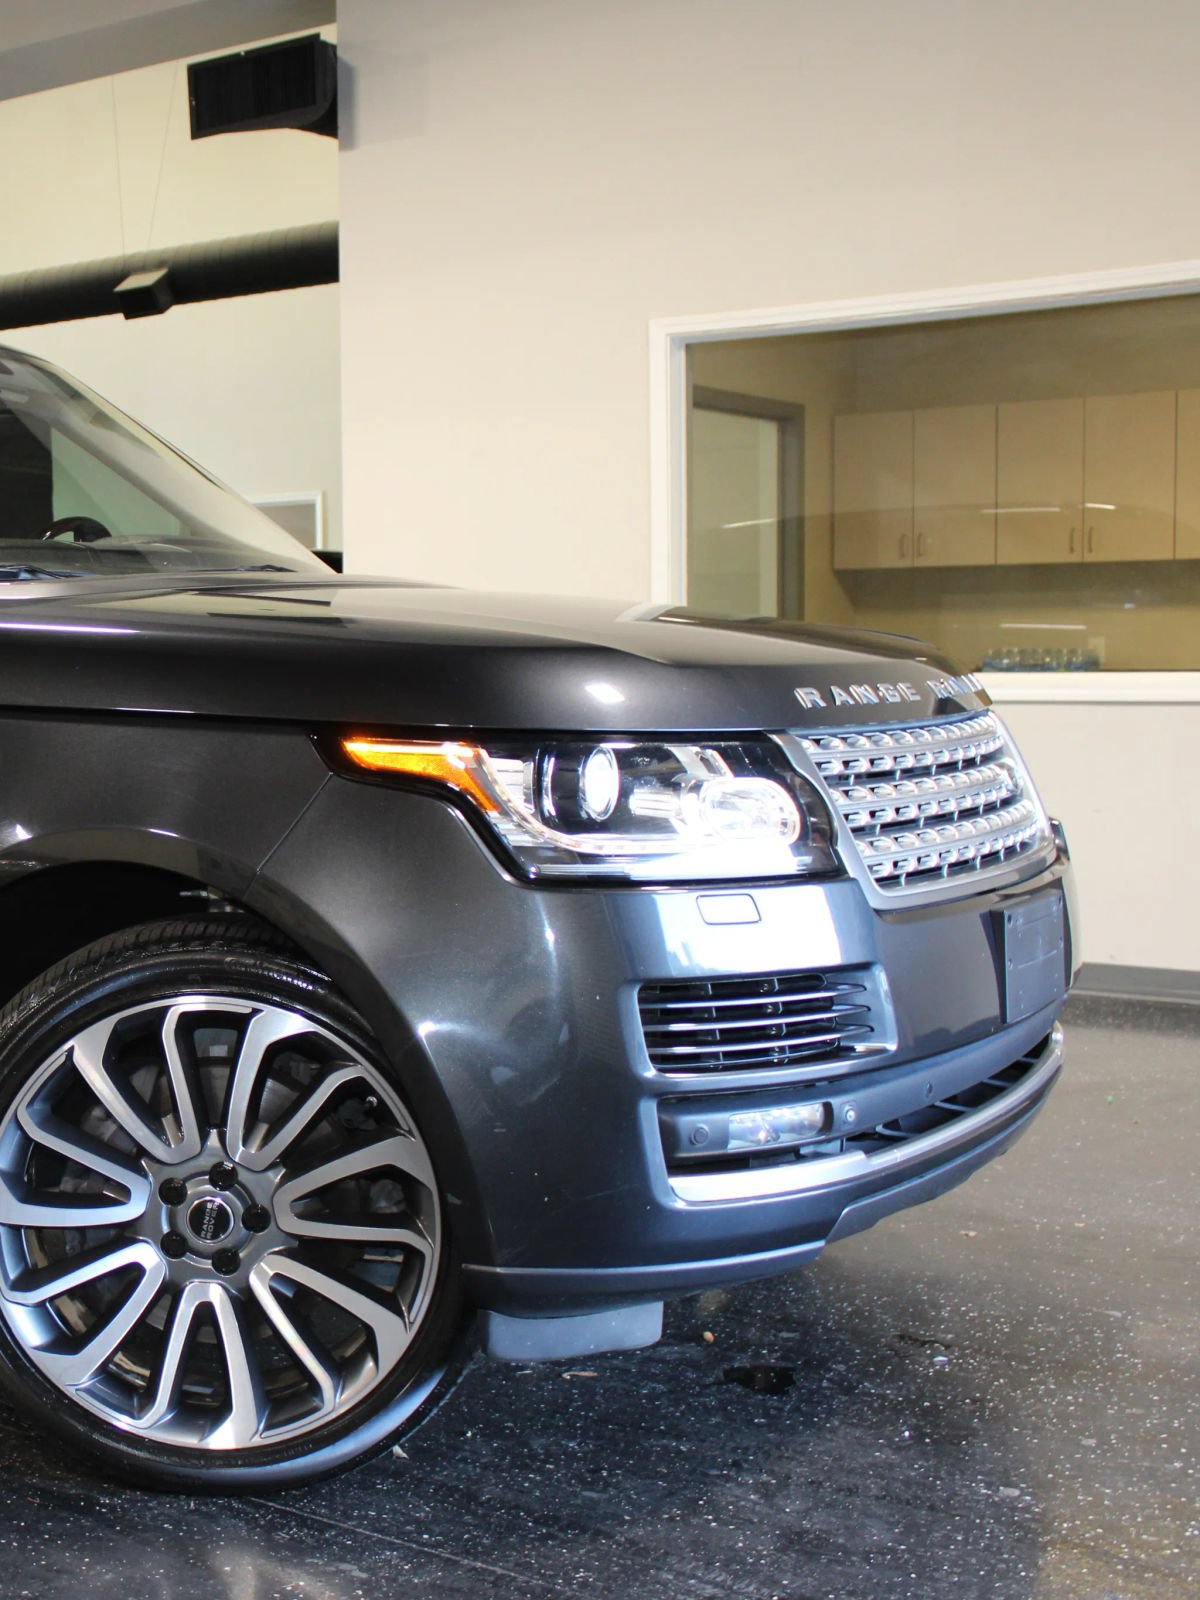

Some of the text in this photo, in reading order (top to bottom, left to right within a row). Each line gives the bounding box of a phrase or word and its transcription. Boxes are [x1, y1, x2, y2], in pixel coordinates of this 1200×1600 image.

[793, 682, 922, 710] RANGE
[200, 1202, 213, 1238] RANGE
[206, 1201, 220, 1239] ROVER
